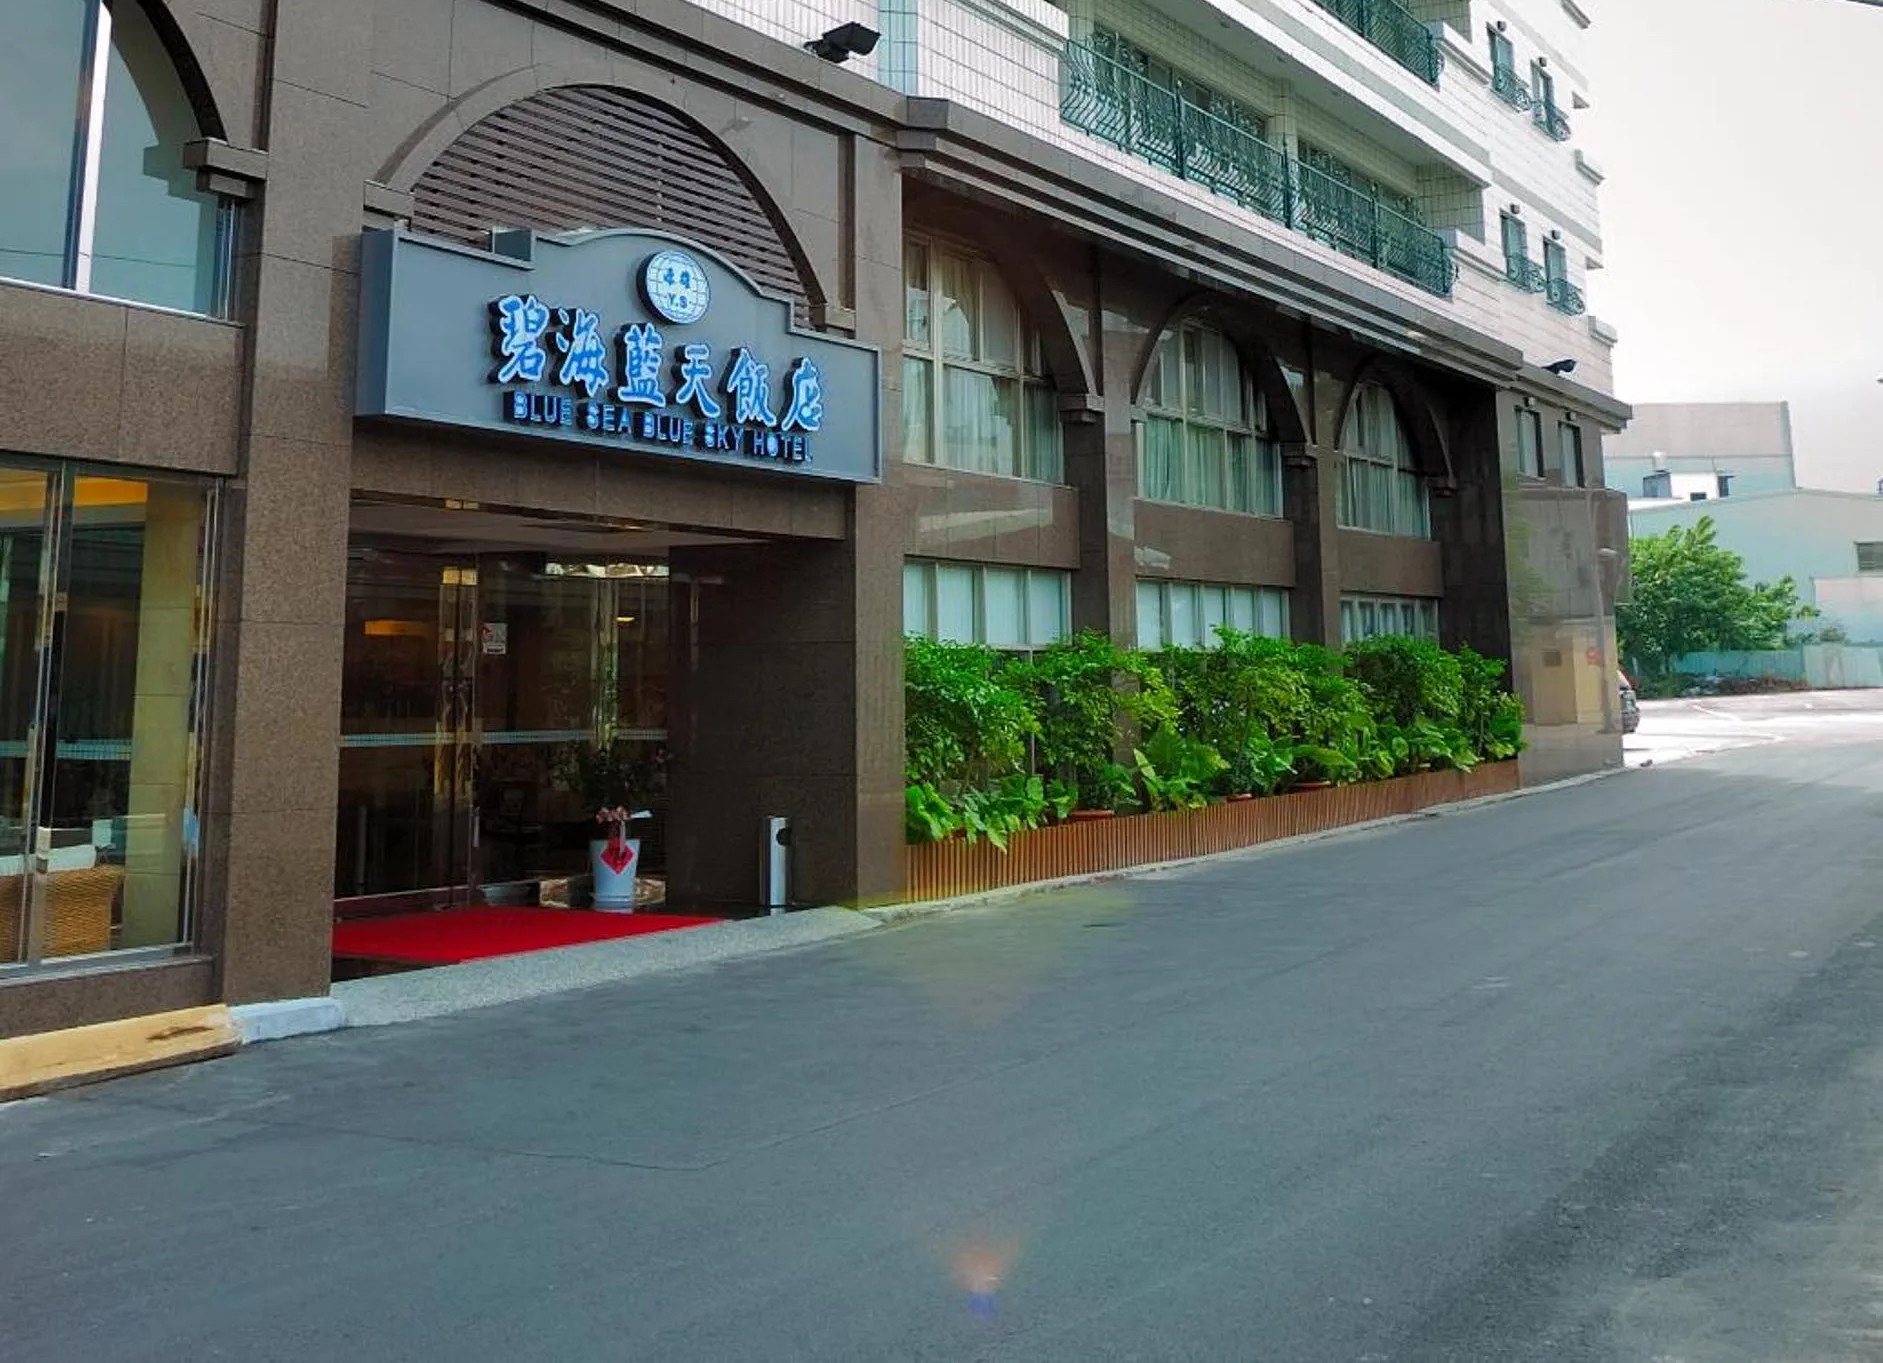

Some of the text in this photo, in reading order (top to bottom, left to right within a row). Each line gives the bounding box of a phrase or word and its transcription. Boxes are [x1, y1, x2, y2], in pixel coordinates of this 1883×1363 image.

[496, 293, 824, 433] 碧海藍天飯店
[513, 390, 813, 463] BLUE SEA BLUE SKY HOTEL
